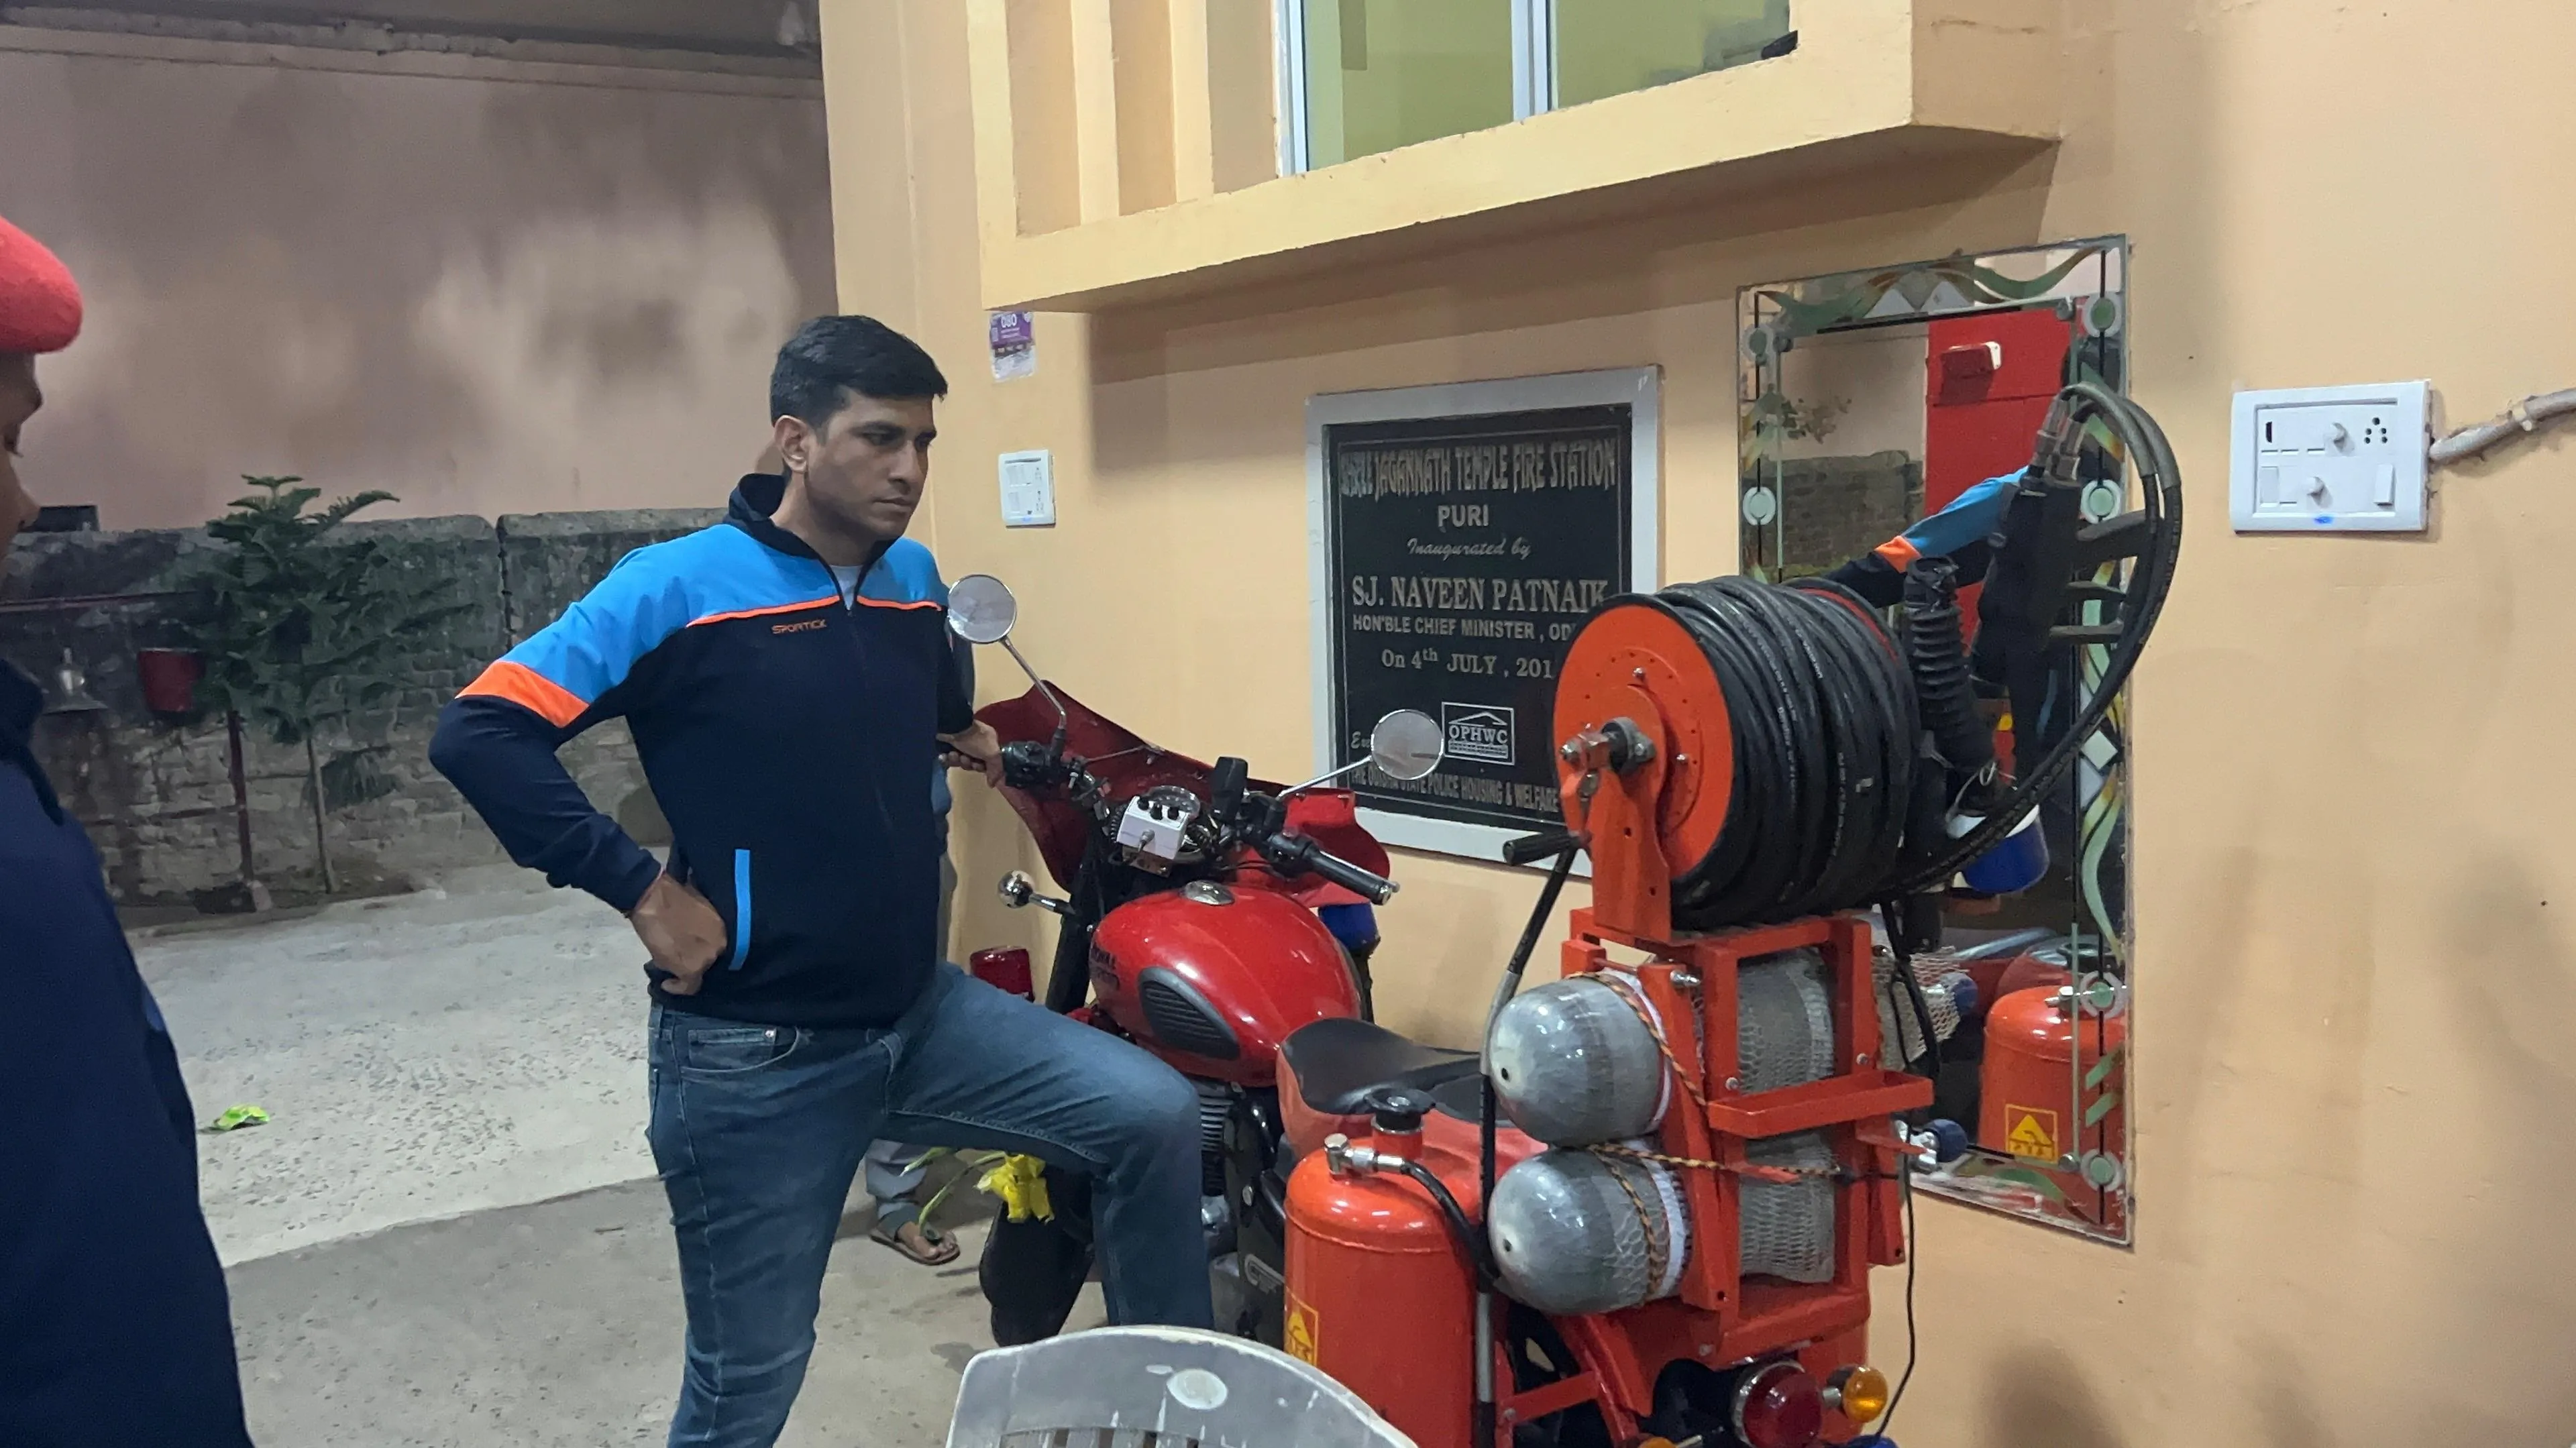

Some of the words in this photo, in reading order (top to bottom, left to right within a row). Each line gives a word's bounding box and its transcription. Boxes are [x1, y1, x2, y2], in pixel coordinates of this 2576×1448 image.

[1375, 447, 1451, 502] JAGANNATH
[1455, 445, 1509, 491] TEMPLE
[1513, 442, 1544, 493] FIRE
[1550, 438, 1617, 490] STATION
[1438, 504, 1489, 527] PURI
[1407, 537, 1507, 561] Inaugurated
[1511, 536, 1531, 560] by
[1352, 575, 1385, 606] SJ.
[1391, 576, 1485, 610] NAVEEN
[1492, 578, 1609, 613] PATNAIK
[1352, 614, 1410, 633] HON'BLE
[1415, 618, 1456, 636] CHIEF
[1461, 619, 1535, 640] MINISTER
[1382, 649, 1406, 668] On
[1411, 647, 1439, 669] 4th
[1446, 653, 1497, 675] JULY
[1516, 657, 1552, 679] 201
[1448, 724, 1509, 744] OPHWC
